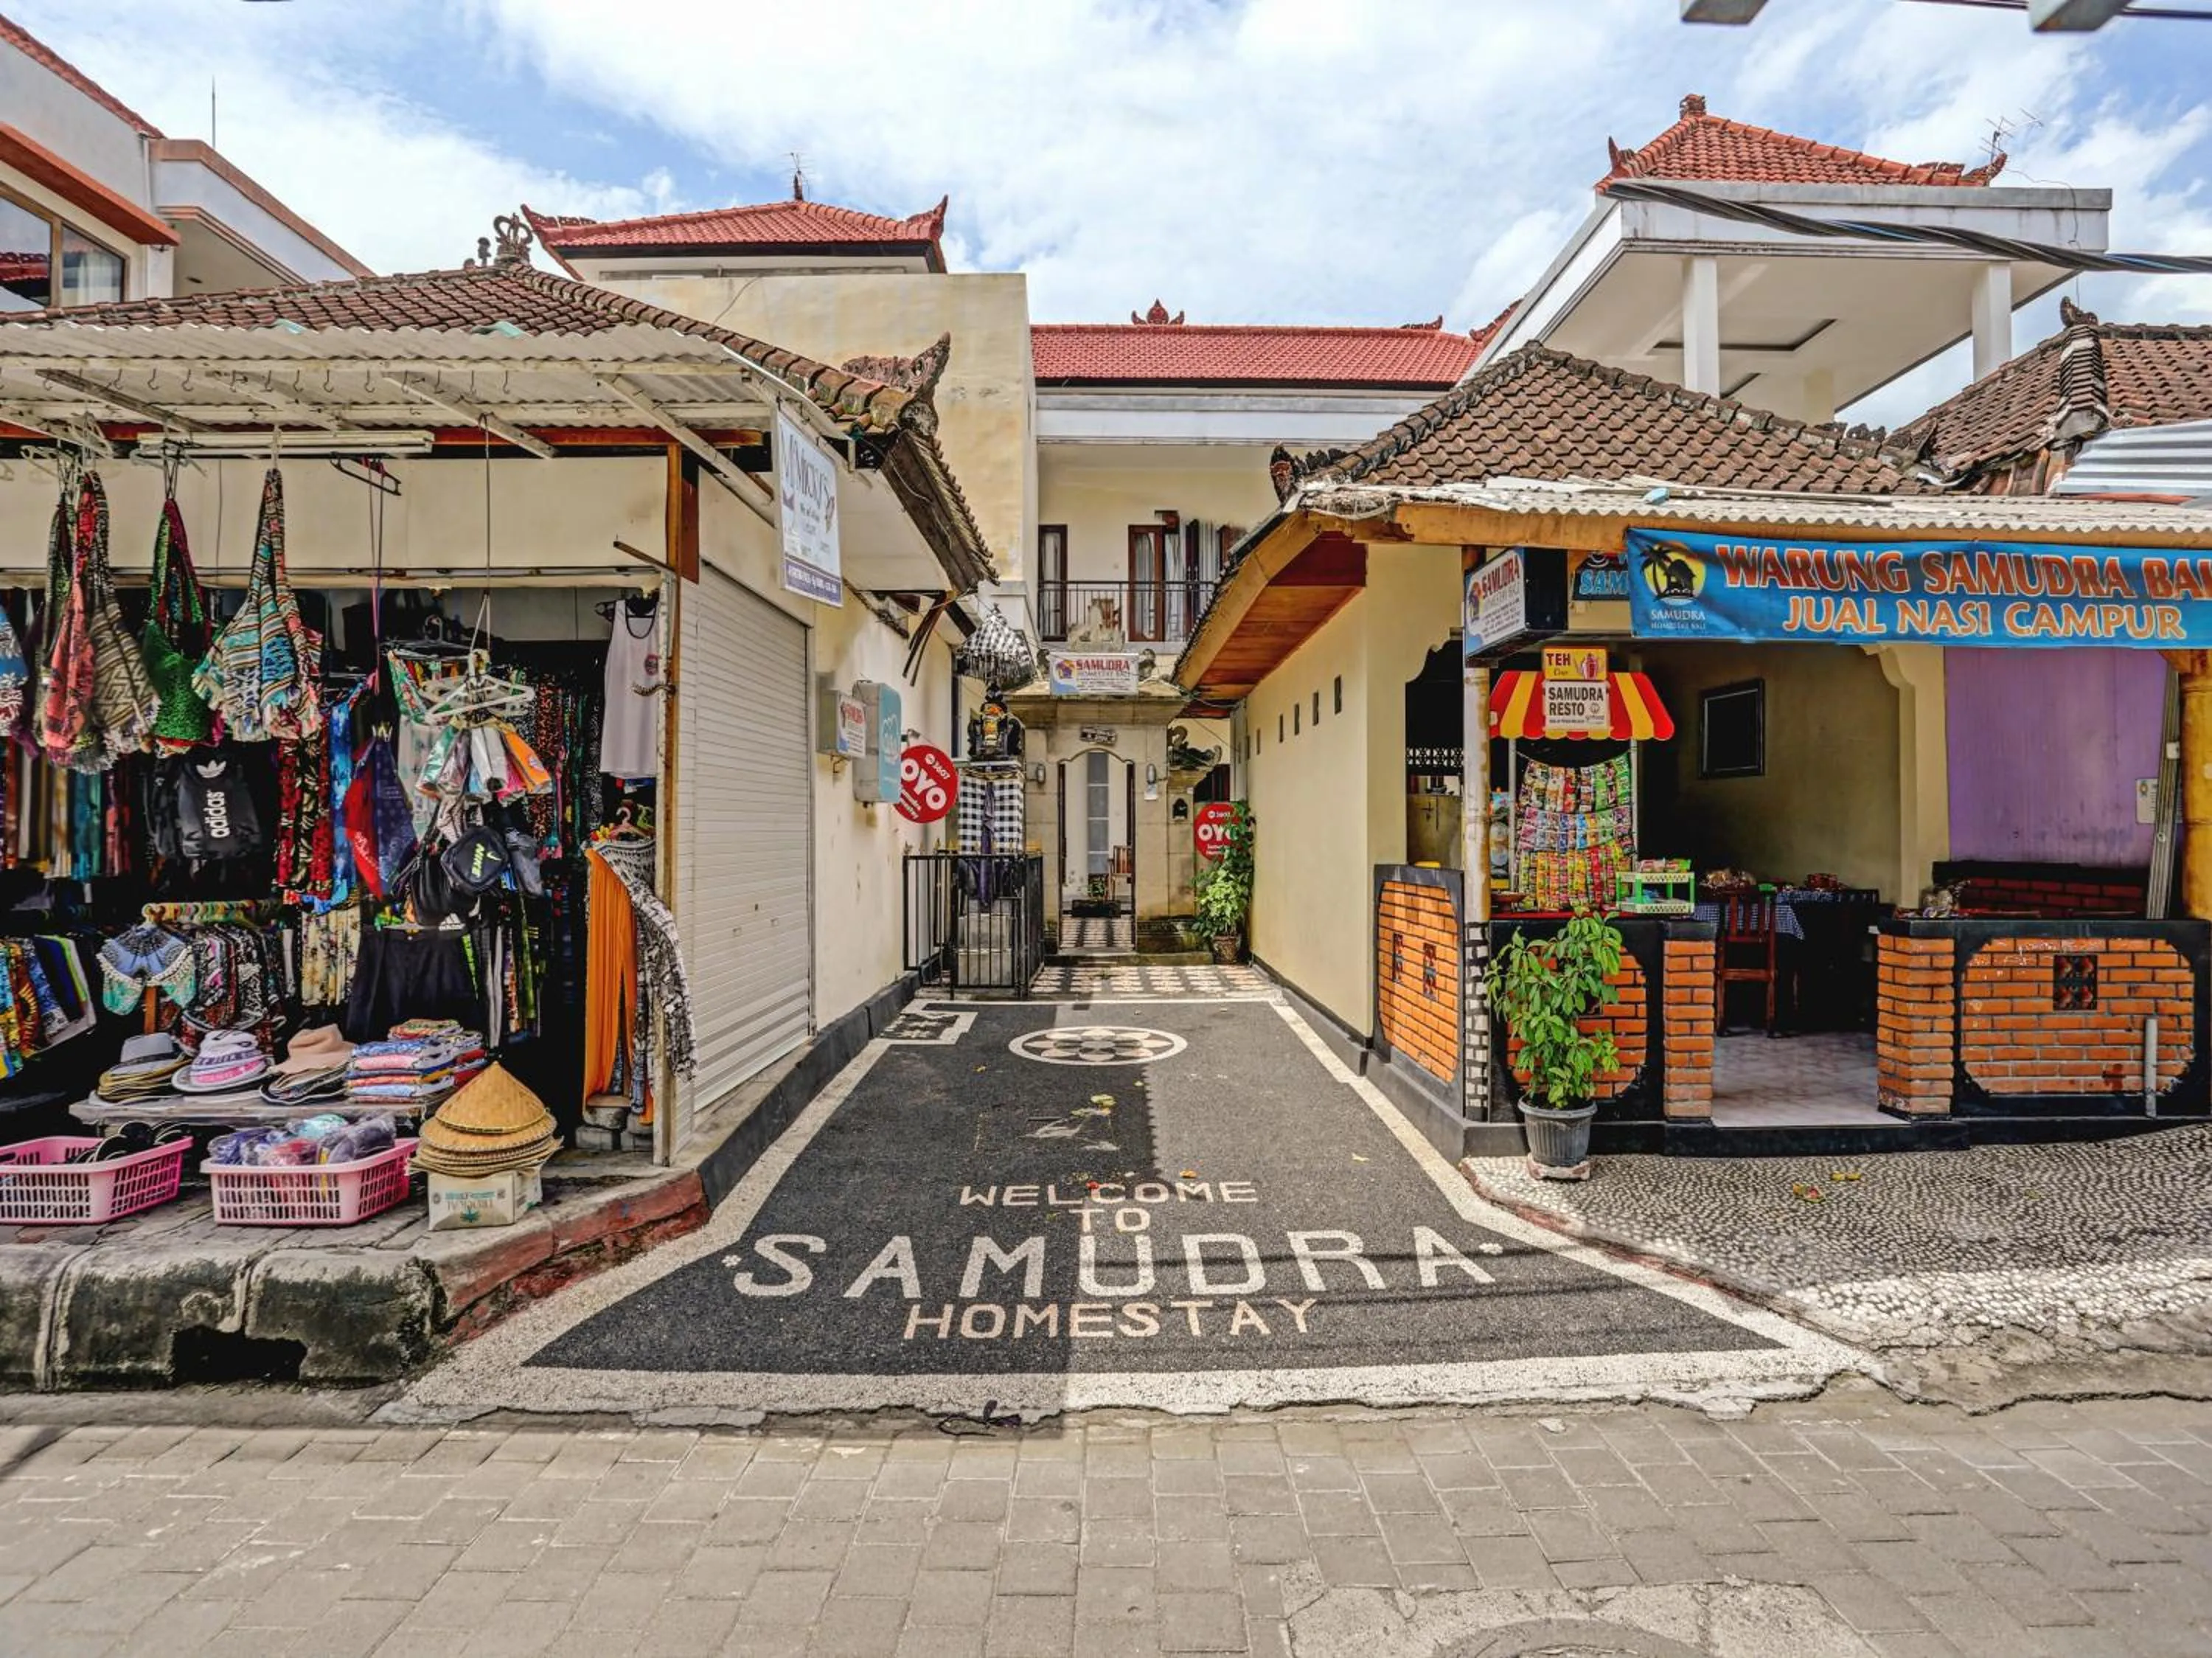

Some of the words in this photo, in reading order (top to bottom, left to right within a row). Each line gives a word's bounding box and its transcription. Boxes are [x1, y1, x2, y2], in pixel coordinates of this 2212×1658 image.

[1715, 544, 1911, 593] WARUNG
[1921, 551, 2137, 598] SAMUDRA
[1651, 609, 1705, 620] SAMUDRA
[1783, 596, 1886, 634] JUAL
[1896, 599, 1992, 637] NASI
[2004, 602, 2187, 639] CAMPUR
[1076, 659, 1130, 670] SAMUDRA
[1546, 653, 1571, 666] TEH
[1548, 687, 1604, 701] SAMUDRA
[1549, 702, 1585, 715] RESTO
[901, 758, 947, 811] OYO
[203, 790, 230, 838] adidas
[472, 843, 484, 878] NIKE
[959, 1182, 1257, 1206] WELCOME
[1069, 1207, 1150, 1232] TO
[734, 1227, 1495, 1297] SAMUDRA
[903, 1299, 1317, 1339] HOMESTAY
